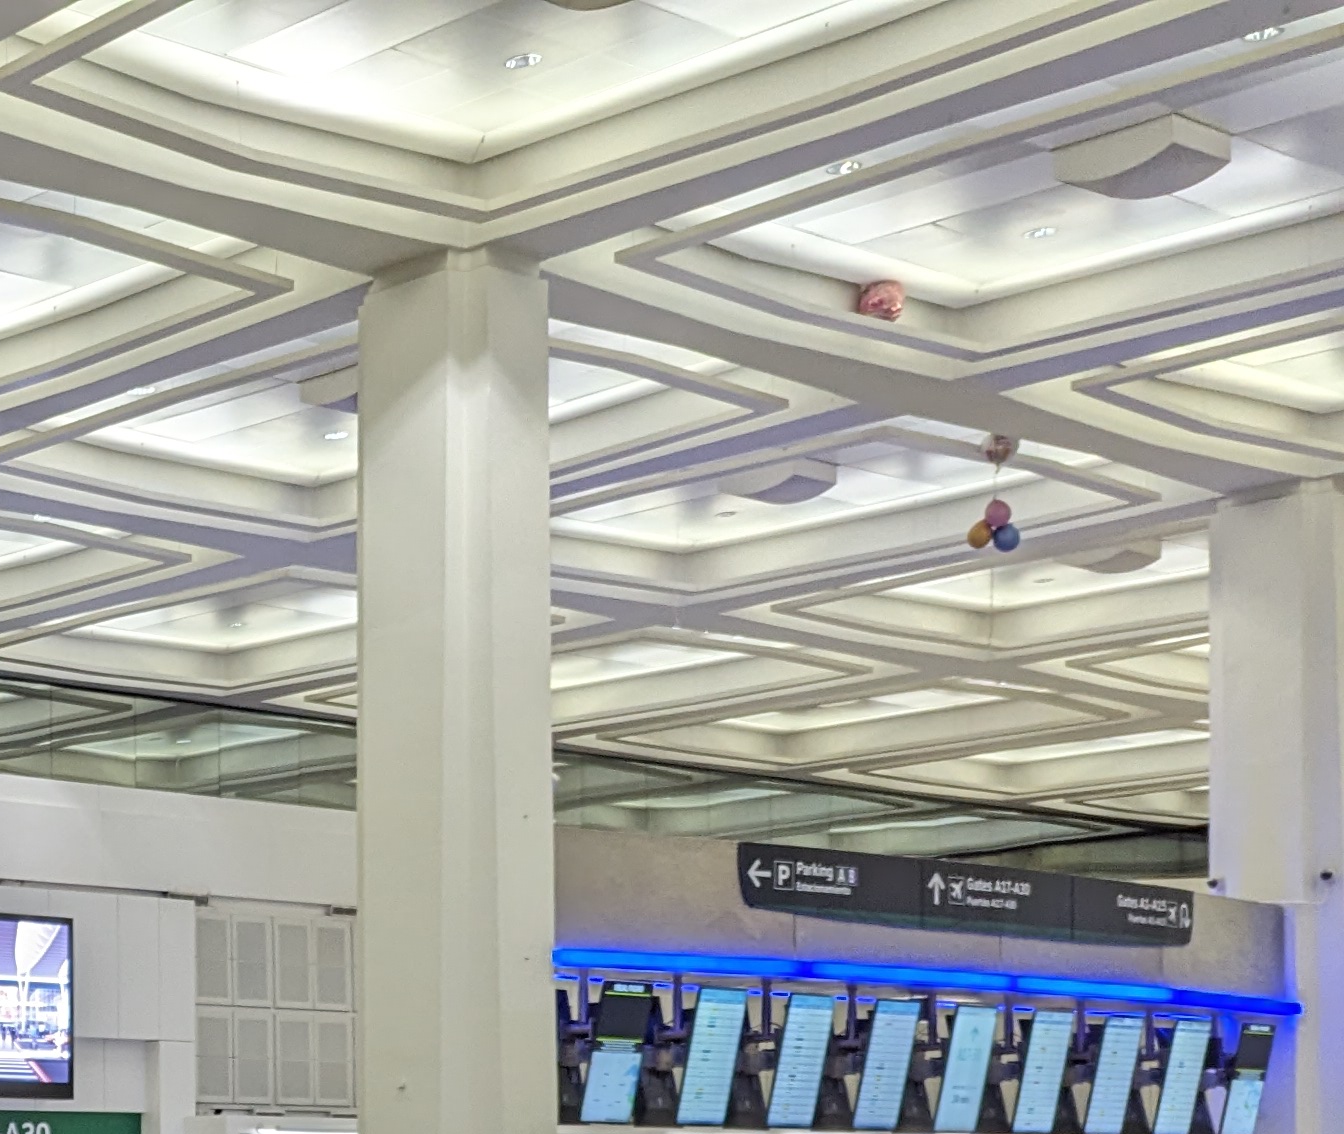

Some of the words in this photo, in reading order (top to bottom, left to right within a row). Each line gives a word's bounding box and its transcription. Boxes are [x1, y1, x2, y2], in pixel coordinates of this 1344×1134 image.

[796, 862, 833, 881] Parking
[967, 878, 993, 893] Gates
[1116, 894, 1139, 909] Gates
